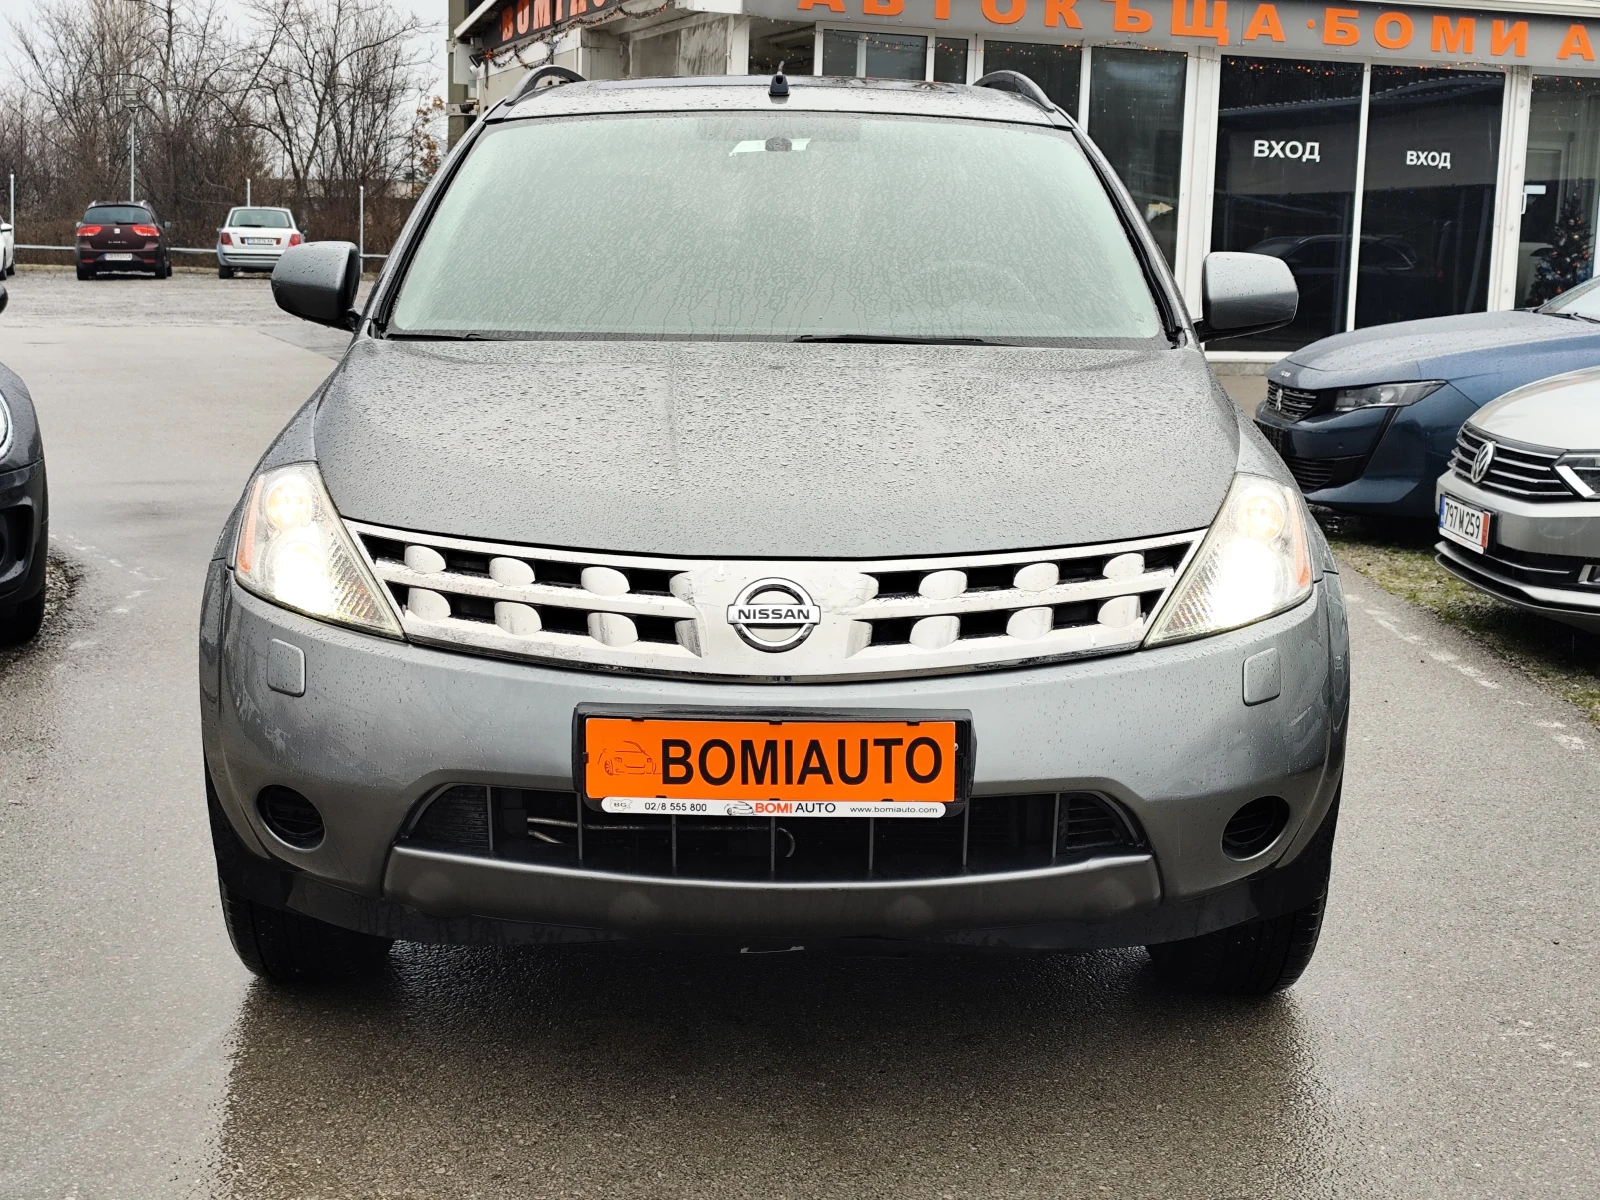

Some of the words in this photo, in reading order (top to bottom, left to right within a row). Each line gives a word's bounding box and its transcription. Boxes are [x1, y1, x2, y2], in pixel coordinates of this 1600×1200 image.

[797, 0, 1286, 46] ОКЪЩА
[1253, 139, 1321, 162] ВХОД
[1405, 150, 1451, 169] ВХОД
[738, 608, 810, 620] NISSAN
[661, 736, 943, 786] BOMIAUTO
[644, 802, 667, 811] 02/8
[670, 802, 687, 812] 555
[690, 803, 707, 812] 800
[755, 802, 793, 814] BOMI
[795, 802, 836, 813] AUTO
[850, 805, 938, 813] www.bomiauto.com
